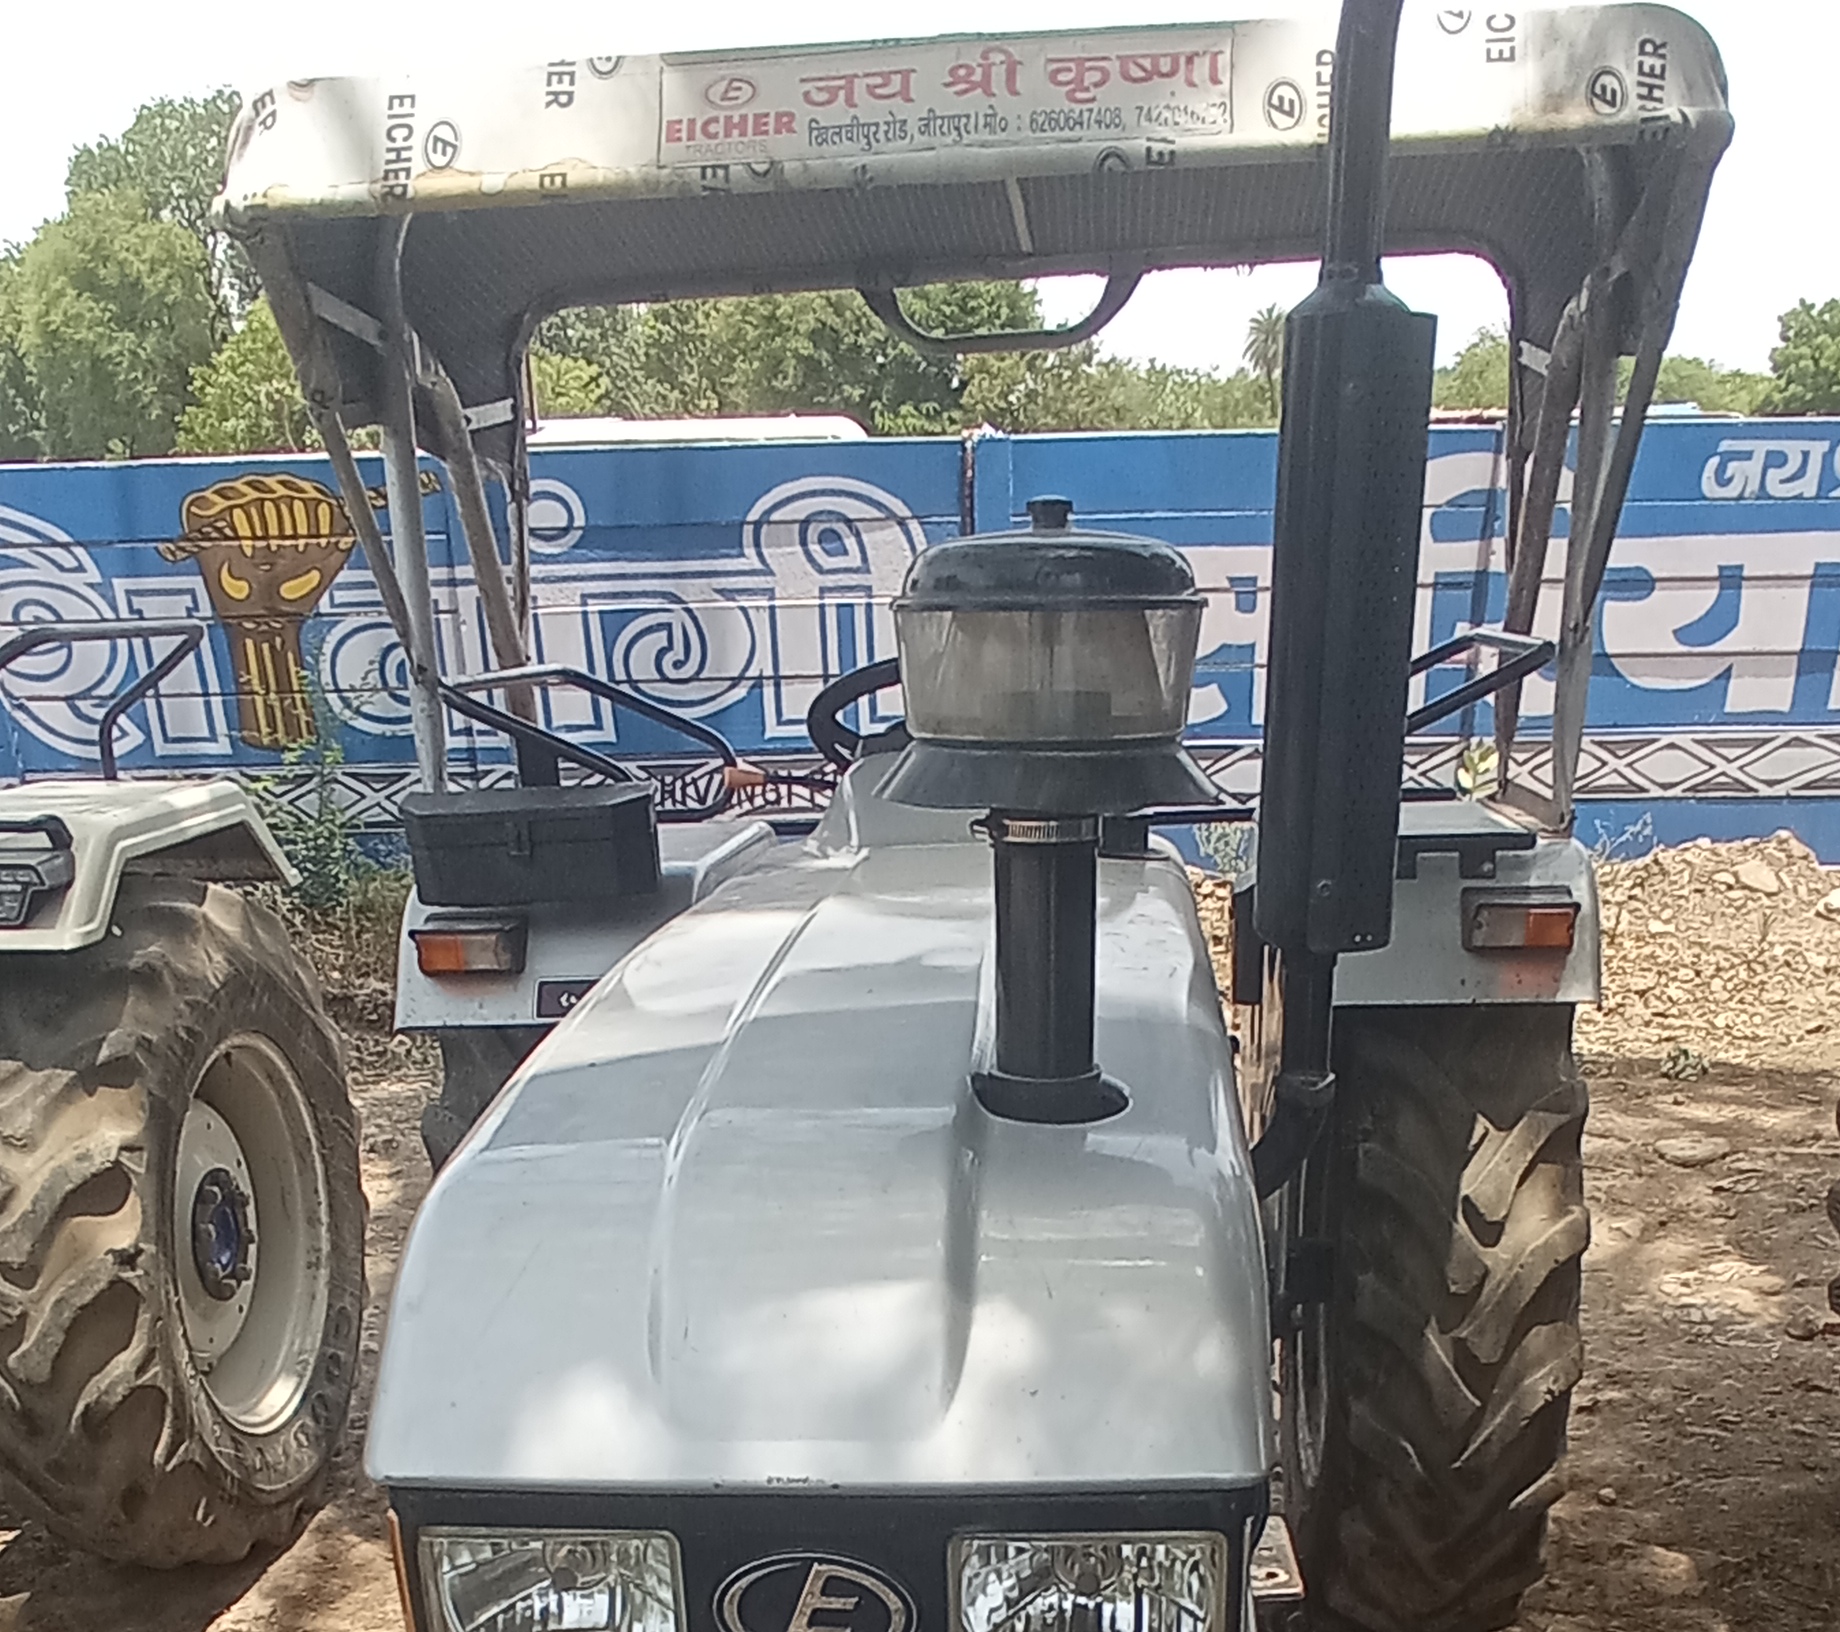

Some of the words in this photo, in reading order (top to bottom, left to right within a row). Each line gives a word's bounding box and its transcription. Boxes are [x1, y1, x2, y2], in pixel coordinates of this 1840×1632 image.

[800, 68, 917, 108] जय
[941, 46, 1024, 98] श्री
[1045, 50, 1225, 104] कृष्णा
[382, 94, 416, 200] EICHER
[664, 110, 798, 144] EICHER
[685, 139, 768, 159] TRACTORS
[1701, 439, 1831, 499] जय
